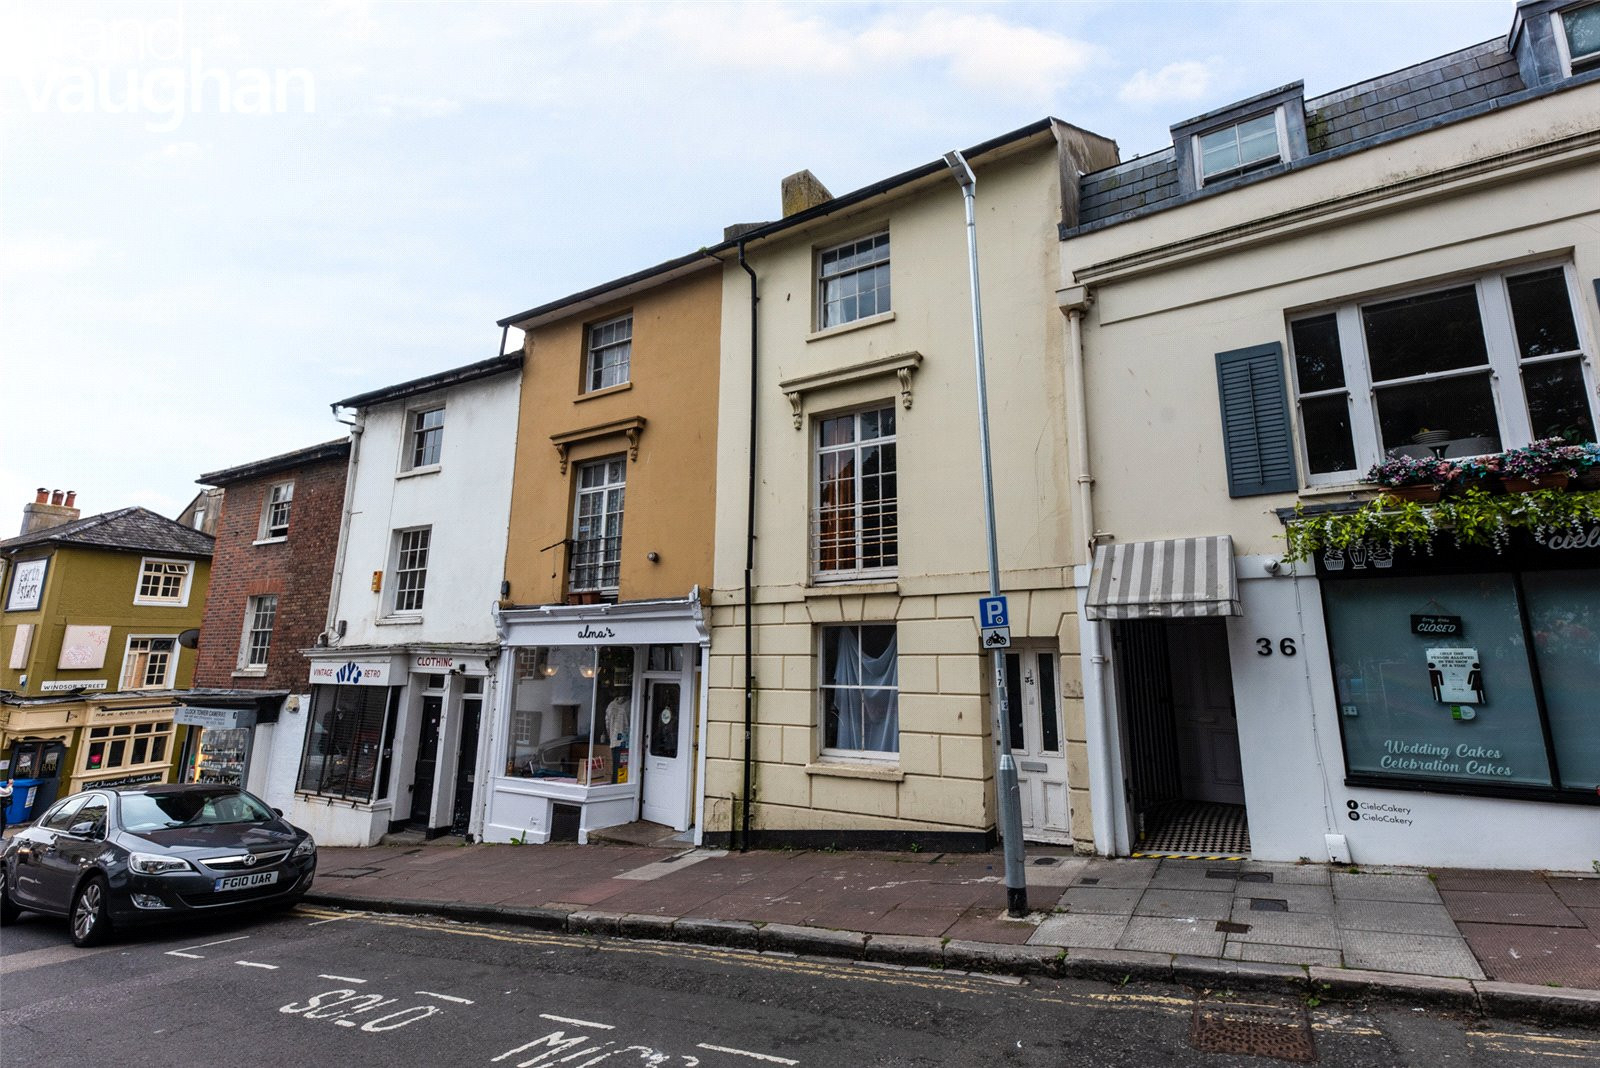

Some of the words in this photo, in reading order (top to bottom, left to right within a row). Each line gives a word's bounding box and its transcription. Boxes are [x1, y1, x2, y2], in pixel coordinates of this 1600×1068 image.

[986, 601, 1003, 624] P
[577, 624, 616, 639] alma's
[1417, 623, 1456, 633] CLOSED
[1256, 637, 1297, 656] 36
[416, 656, 453, 667] CLOTHING
[313, 668, 334, 677] VINTAGE
[364, 669, 382, 678] RETRO
[1384, 740, 1452, 760] Wedding
[1456, 744, 1503, 759] Cakes
[1380, 755, 1461, 773] Celebration
[1466, 760, 1513, 776] Cakes
[1360, 802, 1411, 815] CieloCakery
[1362, 813, 1413, 826] CieloCakery
[222, 876, 249, 889] FG10
[251, 873, 272, 885] UAR
